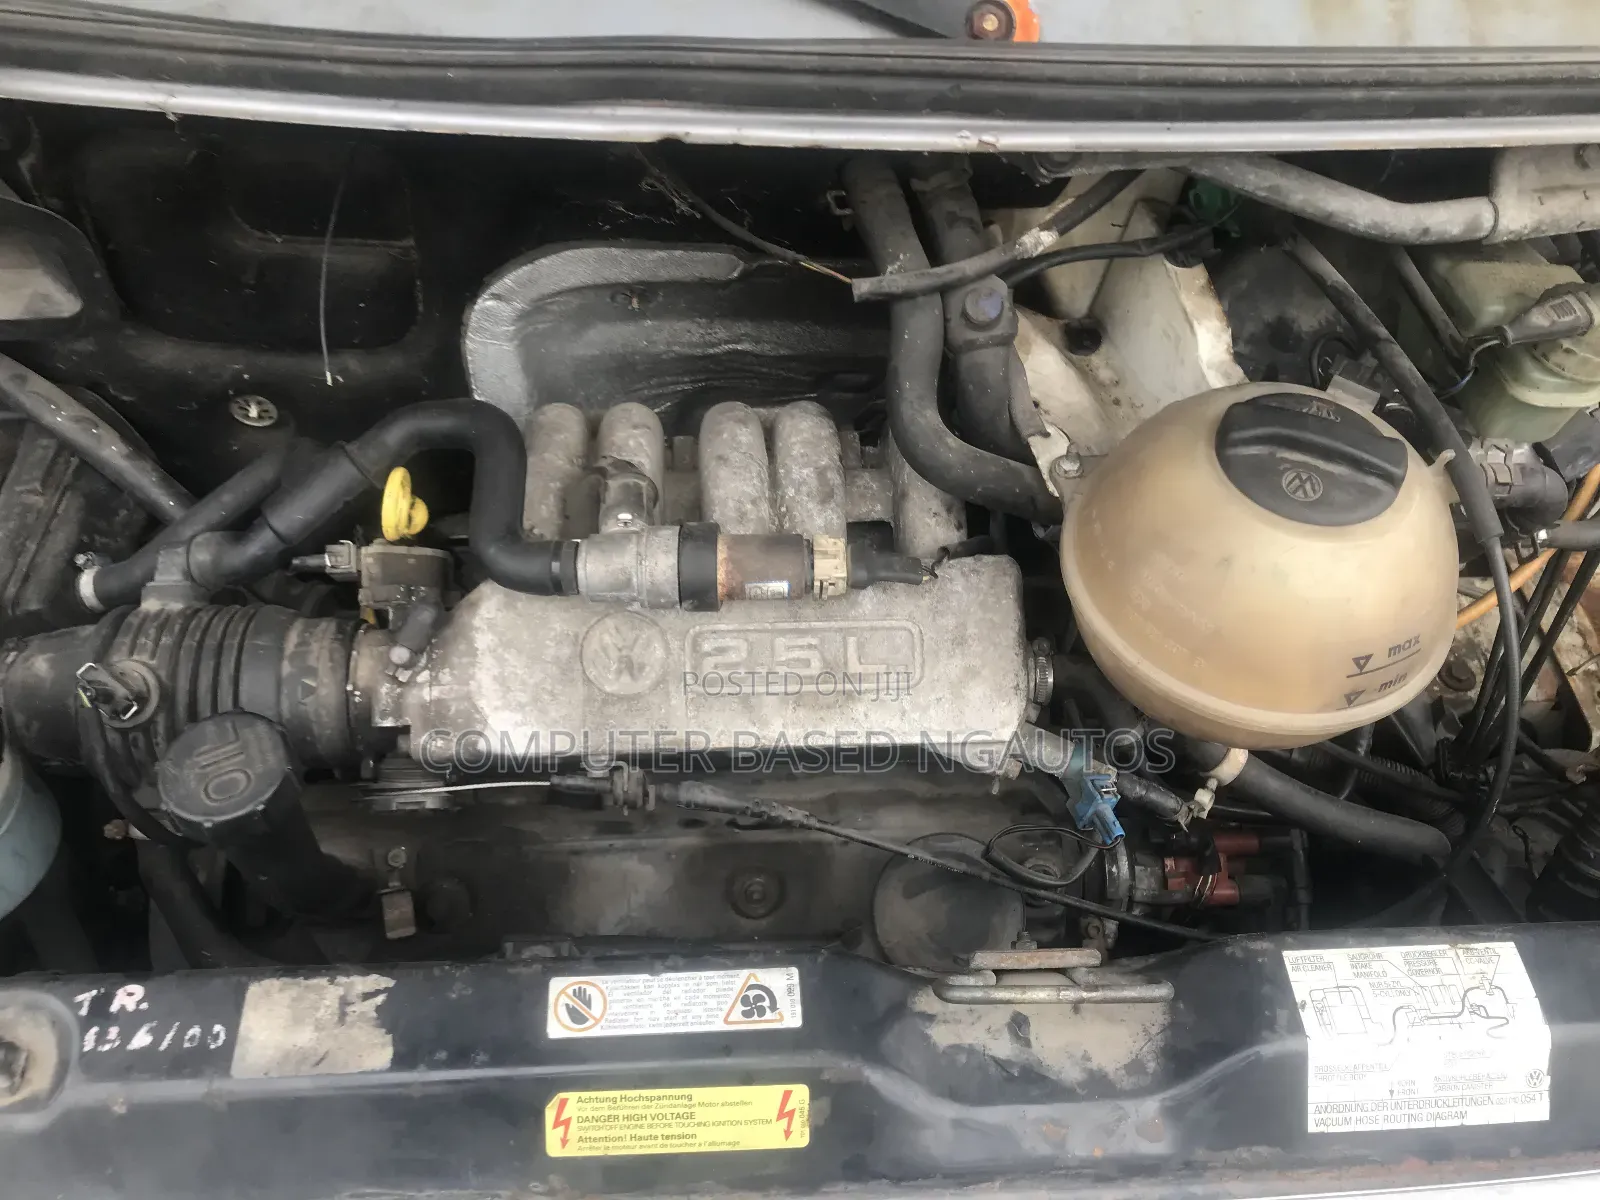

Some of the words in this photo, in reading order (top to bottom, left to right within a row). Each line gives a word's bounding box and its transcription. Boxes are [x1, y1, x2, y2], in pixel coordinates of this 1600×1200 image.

[1388, 634, 1421, 658] max
[1378, 672, 1407, 692] min
[577, 1095, 618, 1104] Achtung
[620, 1093, 693, 1103] Hochspannung
[1314, 1102, 1369, 1114] ANORDNUNG
[1371, 1101, 1389, 1112] DER
[577, 1114, 620, 1124] DANGER
[622, 1113, 648, 1122] HIGH
[650, 1111, 696, 1121] VOLTAGE
[743, 1118, 773, 1126] SYSTEM
[1314, 1116, 1352, 1127] VACUUM
[1355, 1114, 1380, 1125] HOSE
[1383, 1112, 1423, 1124] ROUTING
[1426, 1110, 1468, 1122] DIAGRAM
[577, 1134, 627, 1143] Attention!
[629, 1133, 659, 1142] Haute
[660, 1132, 697, 1141] tension
